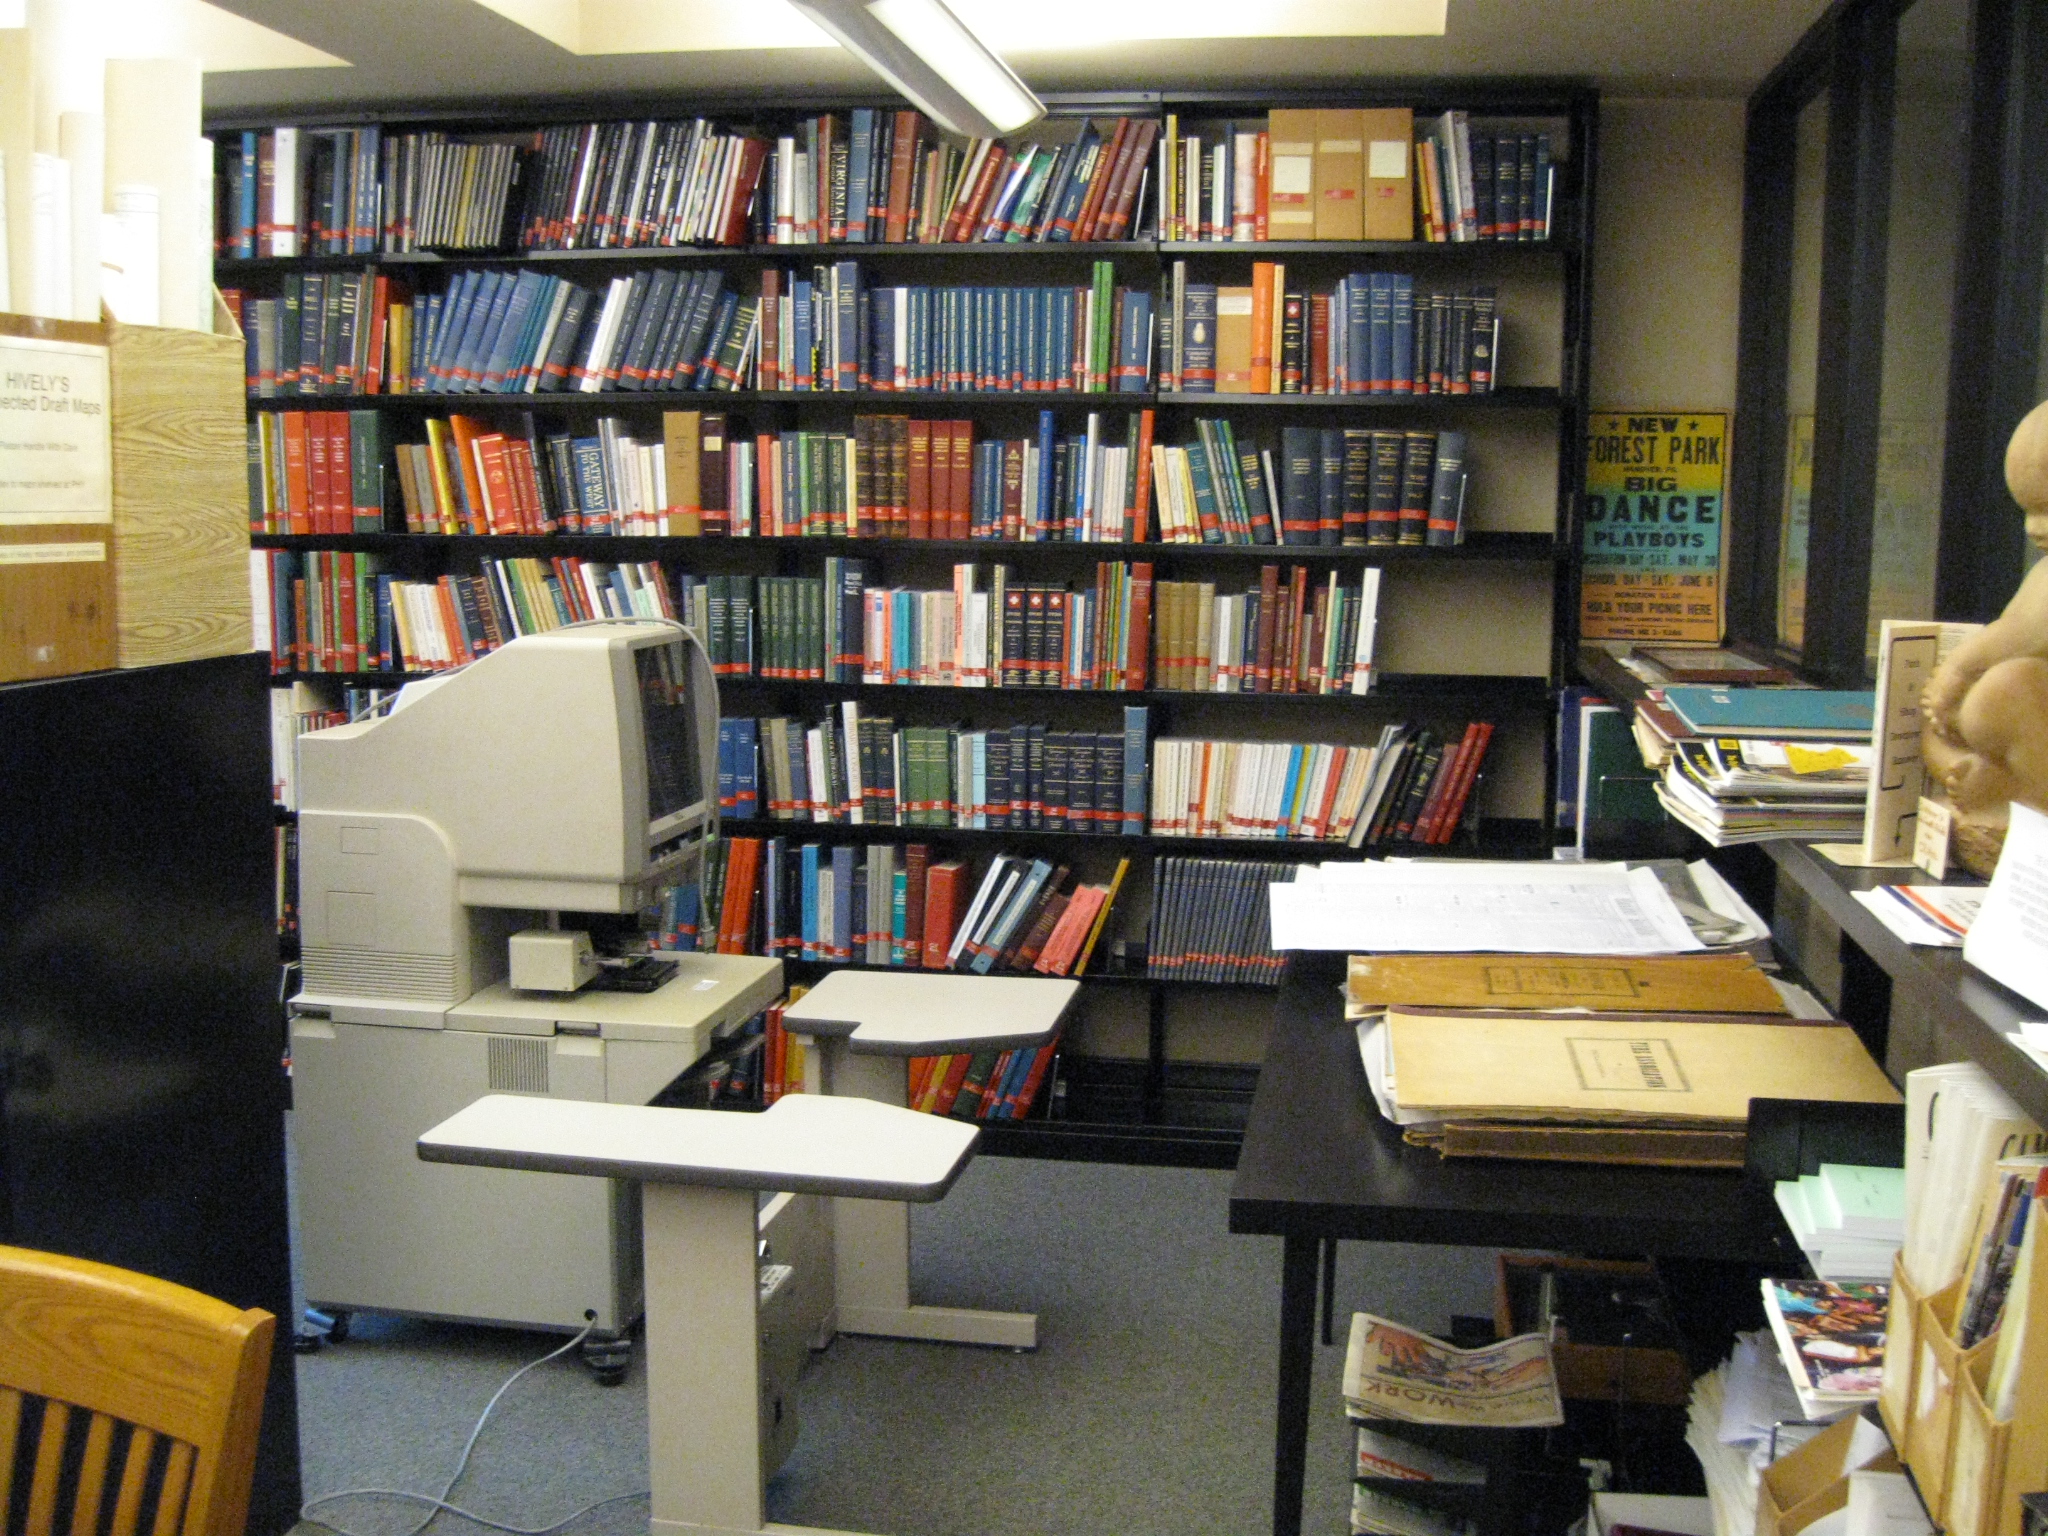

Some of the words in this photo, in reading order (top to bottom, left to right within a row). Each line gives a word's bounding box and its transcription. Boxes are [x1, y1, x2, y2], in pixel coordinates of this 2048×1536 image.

[835, 154, 846, 215] VIRGINIA
[6, 372, 70, 393] HIVELY'S
[40, 396, 69, 412] Draft
[72, 398, 102, 417] Maps
[1628, 418, 1678, 433] NEW
[1587, 435, 1658, 464] FOREST
[1670, 436, 1721, 465] PARK
[589, 452, 605, 508] GATEWAY
[1625, 477, 1677, 492] BIG
[1587, 495, 1716, 524] DANCE
[1594, 532, 1706, 548] PLAYBOYS
[1617, 602, 1643, 613] YOUR
[1649, 603, 1682, 614] PICNIC
[1687, 604, 1712, 615] HERE
[1366, 1379, 1457, 1409] WORK
